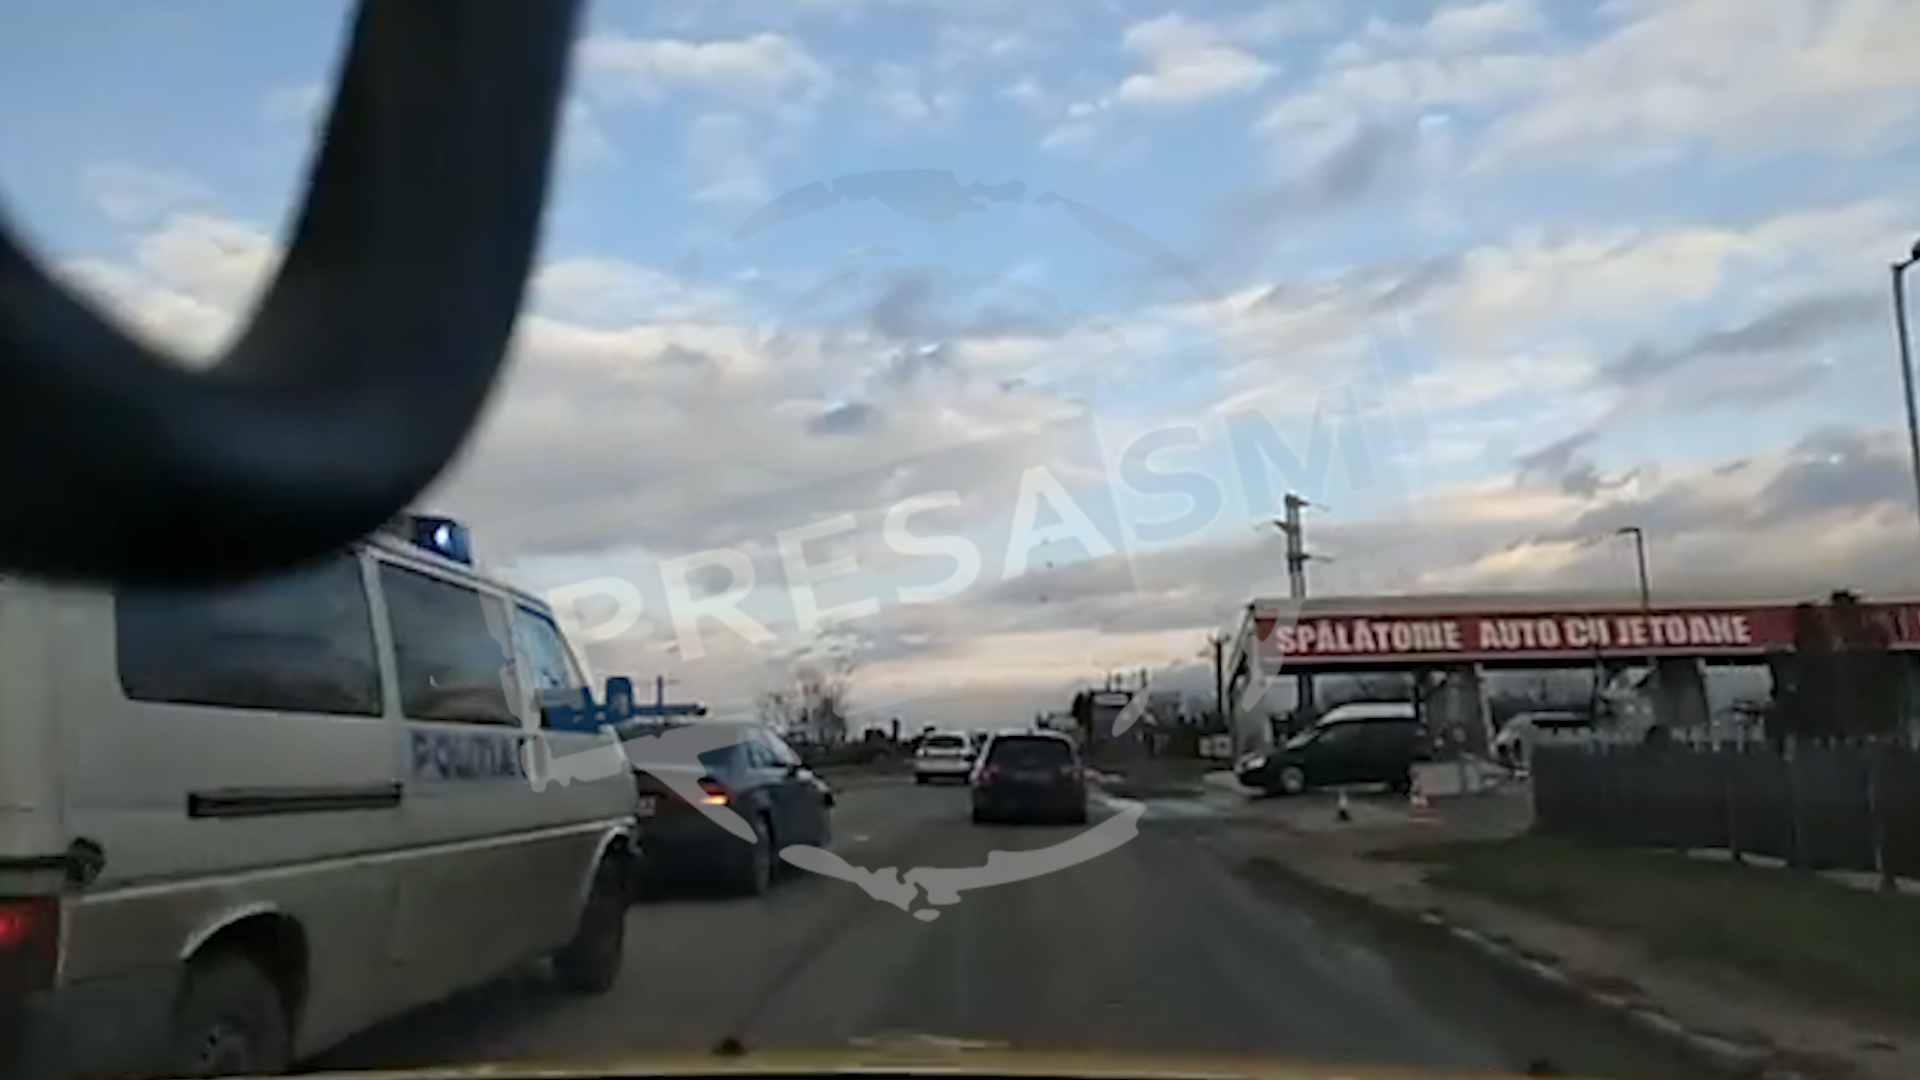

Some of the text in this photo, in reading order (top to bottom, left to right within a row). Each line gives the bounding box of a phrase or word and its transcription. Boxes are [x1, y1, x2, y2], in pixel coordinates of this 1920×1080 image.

[1480, 617, 1559, 649] AUTO
[1563, 615, 1608, 646] CU
[1615, 613, 1751, 646] JETOANE
